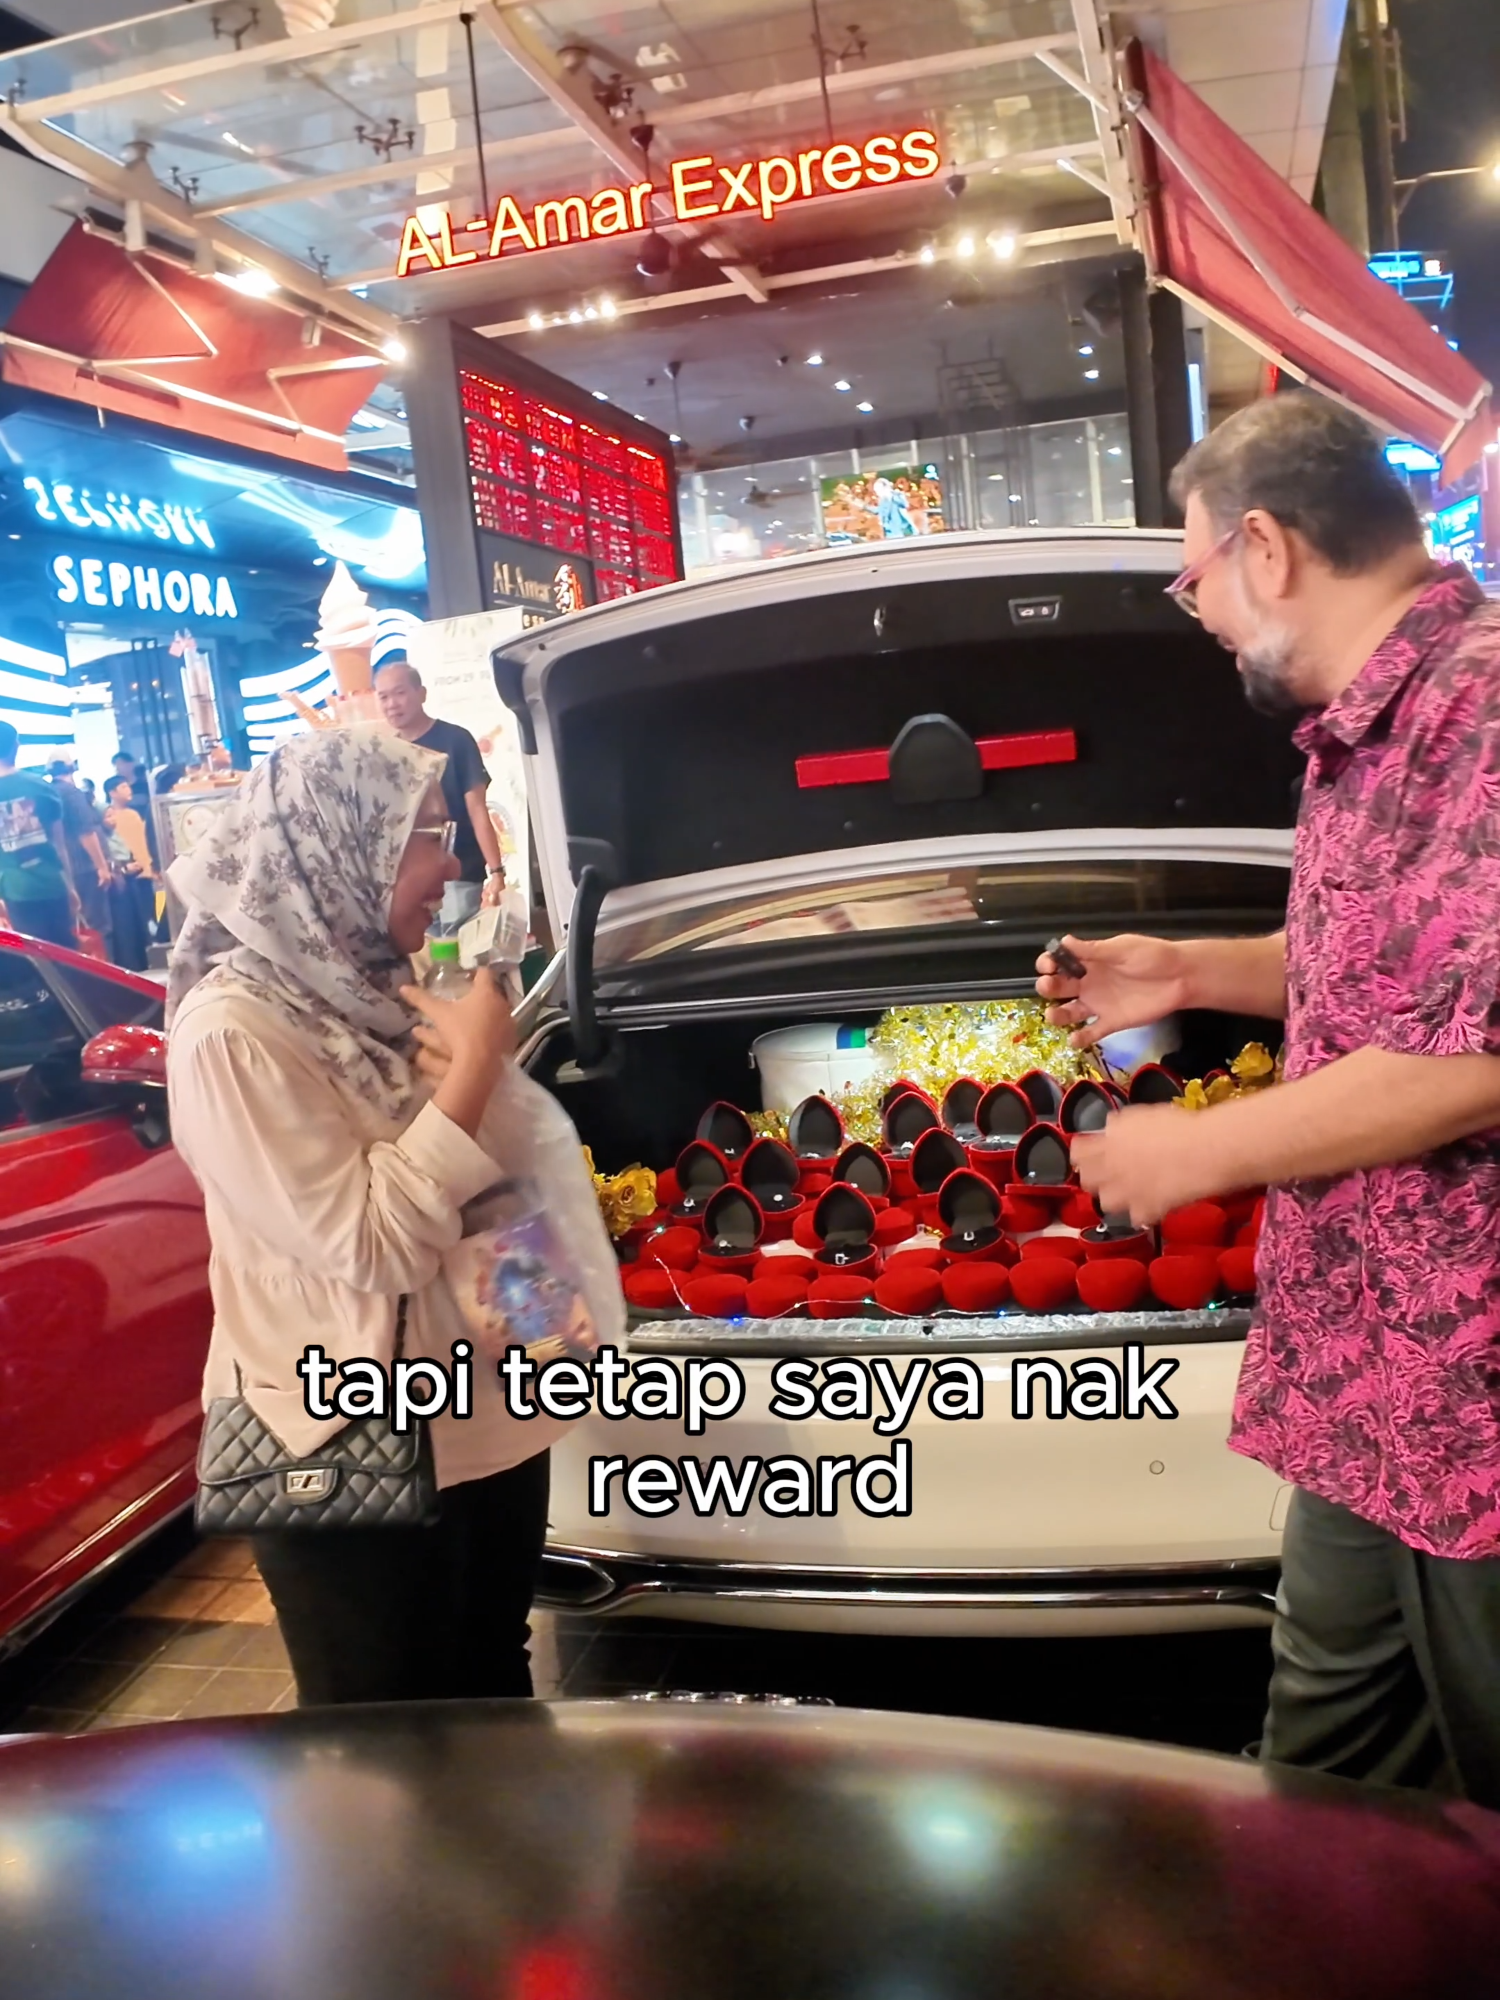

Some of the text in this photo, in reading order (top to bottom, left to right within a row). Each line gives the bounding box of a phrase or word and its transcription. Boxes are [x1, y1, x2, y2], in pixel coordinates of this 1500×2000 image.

[396, 128, 941, 278] AL-Amar Express
[53, 555, 238, 618] SEPHORA
